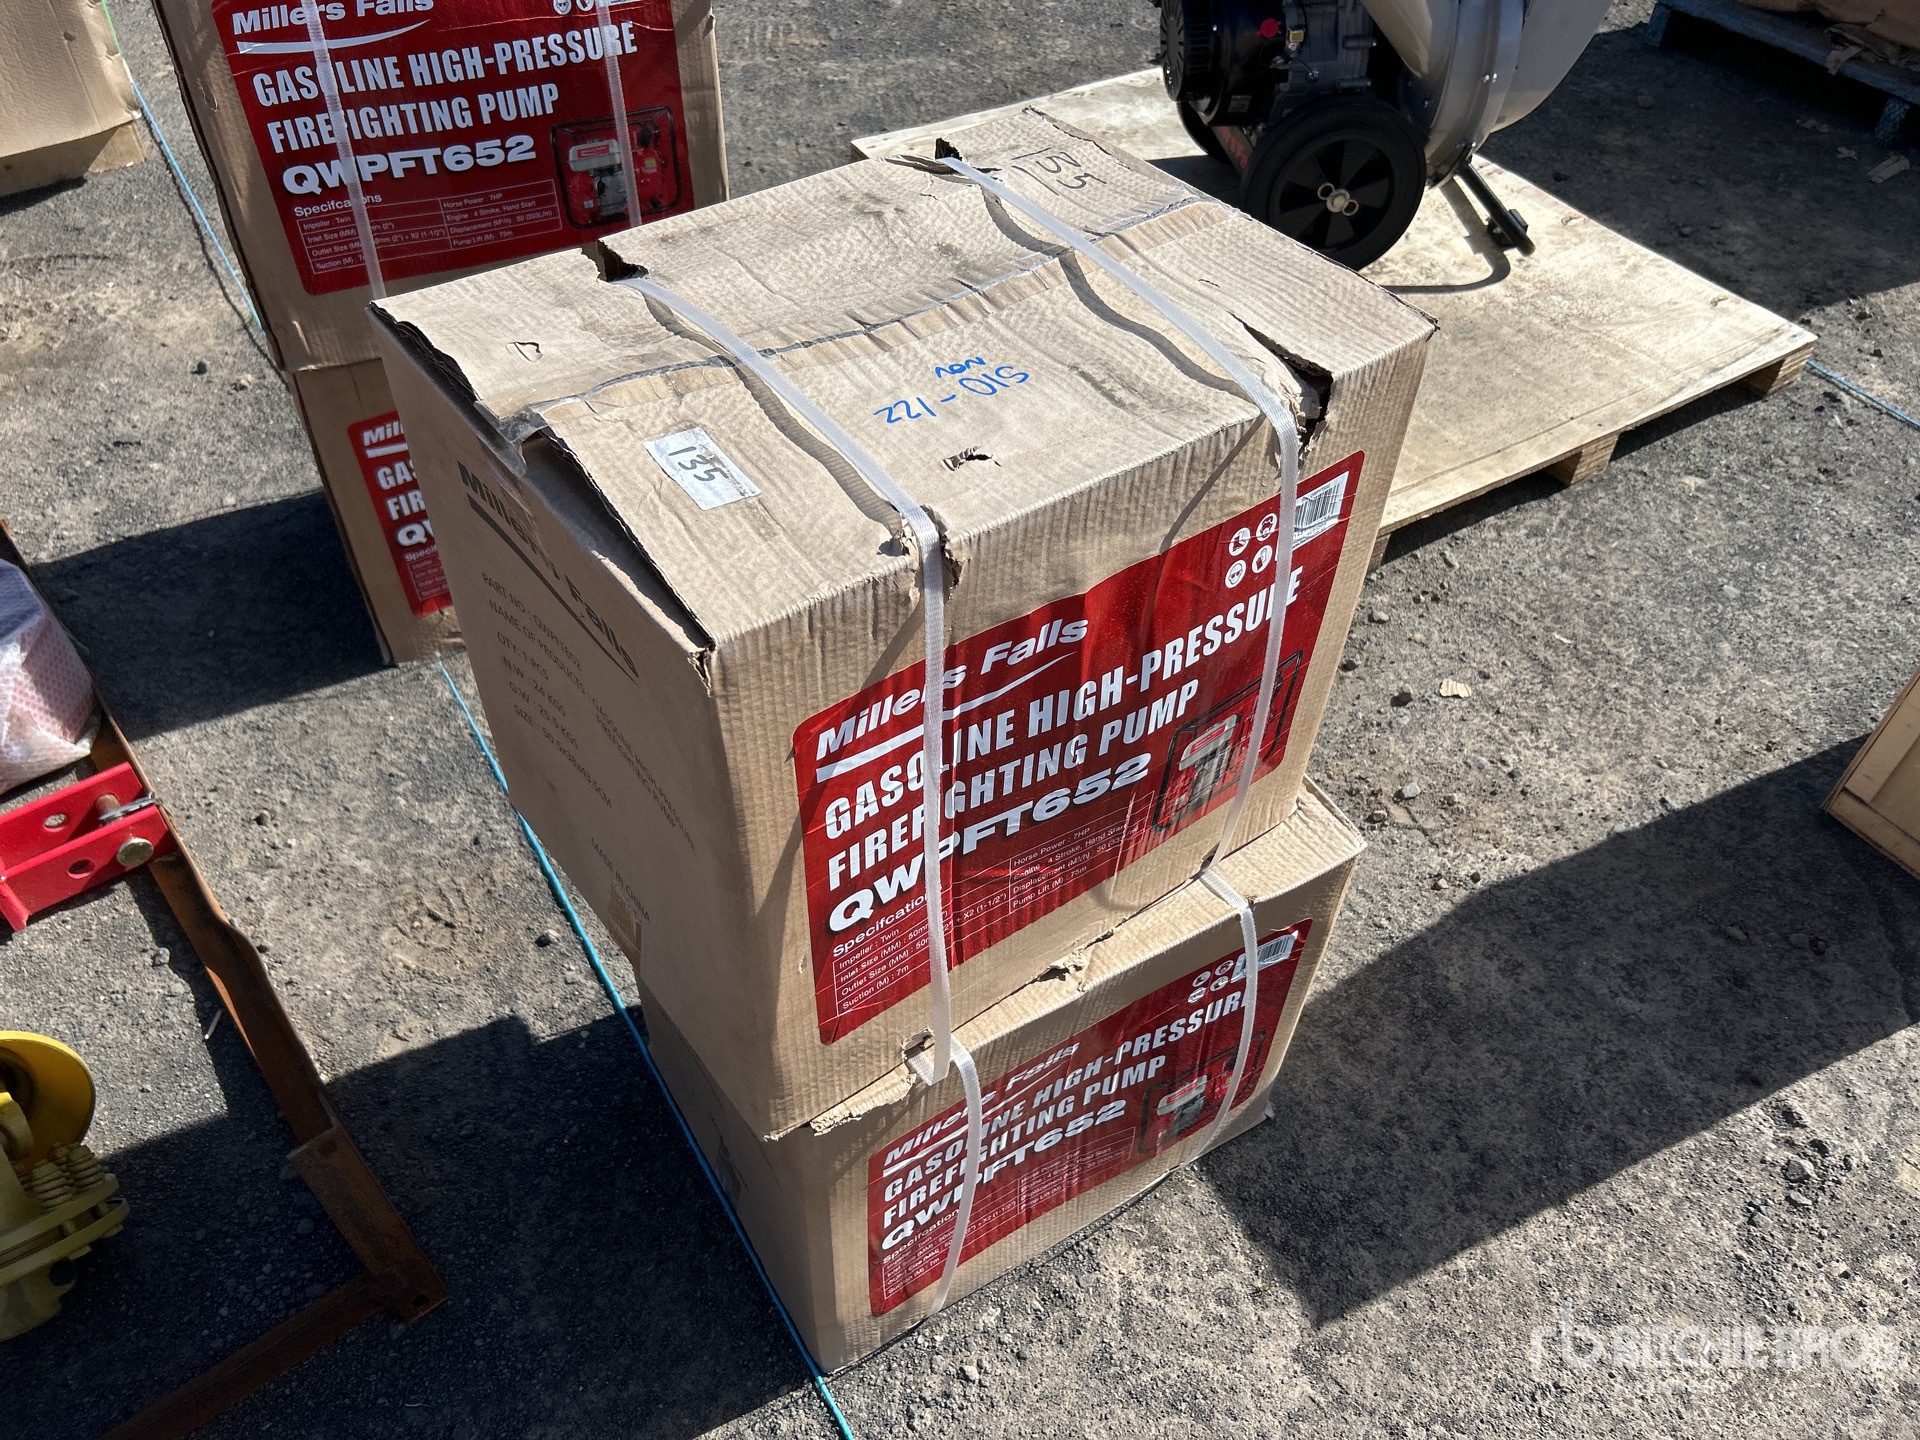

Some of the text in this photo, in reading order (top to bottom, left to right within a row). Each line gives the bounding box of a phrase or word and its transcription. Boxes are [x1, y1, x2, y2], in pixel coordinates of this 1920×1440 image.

[356, 0, 434, 17] Falls
[252, 20, 638, 107] GASLINE HIGH-PRESSURE
[267, 83, 560, 154] FIREIGHTING PUMP
[282, 134, 537, 195] QWPFT652
[294, 194, 382, 218] Specifcaons
[668, 446, 727, 482] 135
[482, 572, 507, 598] PART
[490, 601, 521, 631] NAME
[567, 575, 637, 676] Falls
[979, 616, 1090, 676] Falls
[824, 706, 1016, 843] GASOINE
[827, 675, 1200, 892] FIREFGHTING PUMP
[828, 748, 1153, 932] QWPFT652
[1013, 827, 1090, 866] Horse Power 7HP
[1085, 831, 1106, 846] Hand
[1012, 862, 1066, 895] Displacement
[1013, 891, 1035, 908] Pump
[1037, 883, 1050, 895] Lift
[1070, 865, 1086, 877] 75m
[832, 884, 942, 957] Specifcatio
[839, 927, 898, 969] Impeller Twin
[840, 966, 858, 982] Inlet
[861, 953, 878, 968] Size
[880, 938, 901, 957] (MM)
[842, 975, 866, 995] Outlet
[869, 963, 886, 979] Size
[888, 948, 908, 967] (MM)
[963, 908, 974, 919] X2
[842, 963, 909, 1009] Suction (M) 7m
[884, 990, 1249, 1201] GASOINE HIGH-PRESSUR
[1082, 1051, 1167, 1106] PUMP
[883, 1209, 960, 1262] Specifcation
